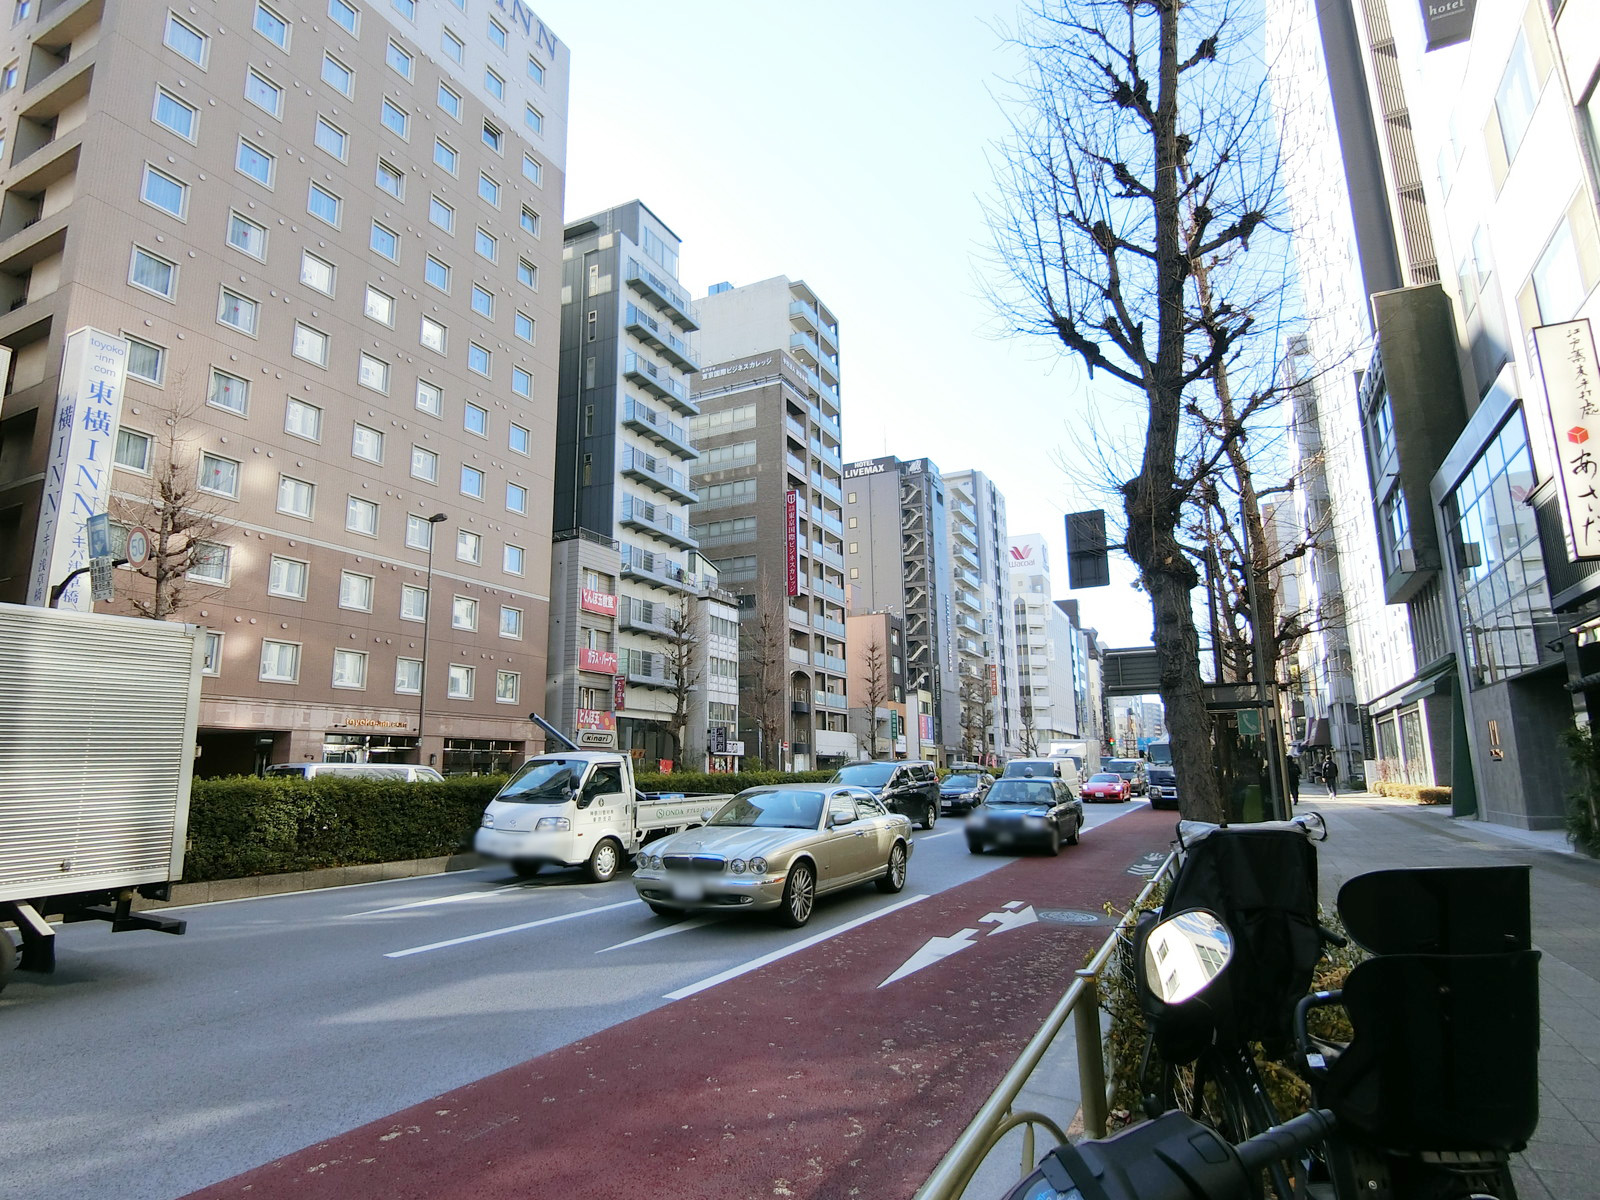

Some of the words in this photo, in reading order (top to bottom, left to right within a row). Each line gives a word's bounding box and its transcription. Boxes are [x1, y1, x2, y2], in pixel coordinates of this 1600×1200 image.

[1429, 0, 1465, 16] hotel
[91, 337, 125, 356] toyoko
[43, 394, 73, 515] 横INN
[844, 464, 885, 479] LIVEMAX
[854, 459, 875, 469] HOTEL
[131, 537, 145, 557] 50
[579, 710, 600, 724] とんぼ玉
